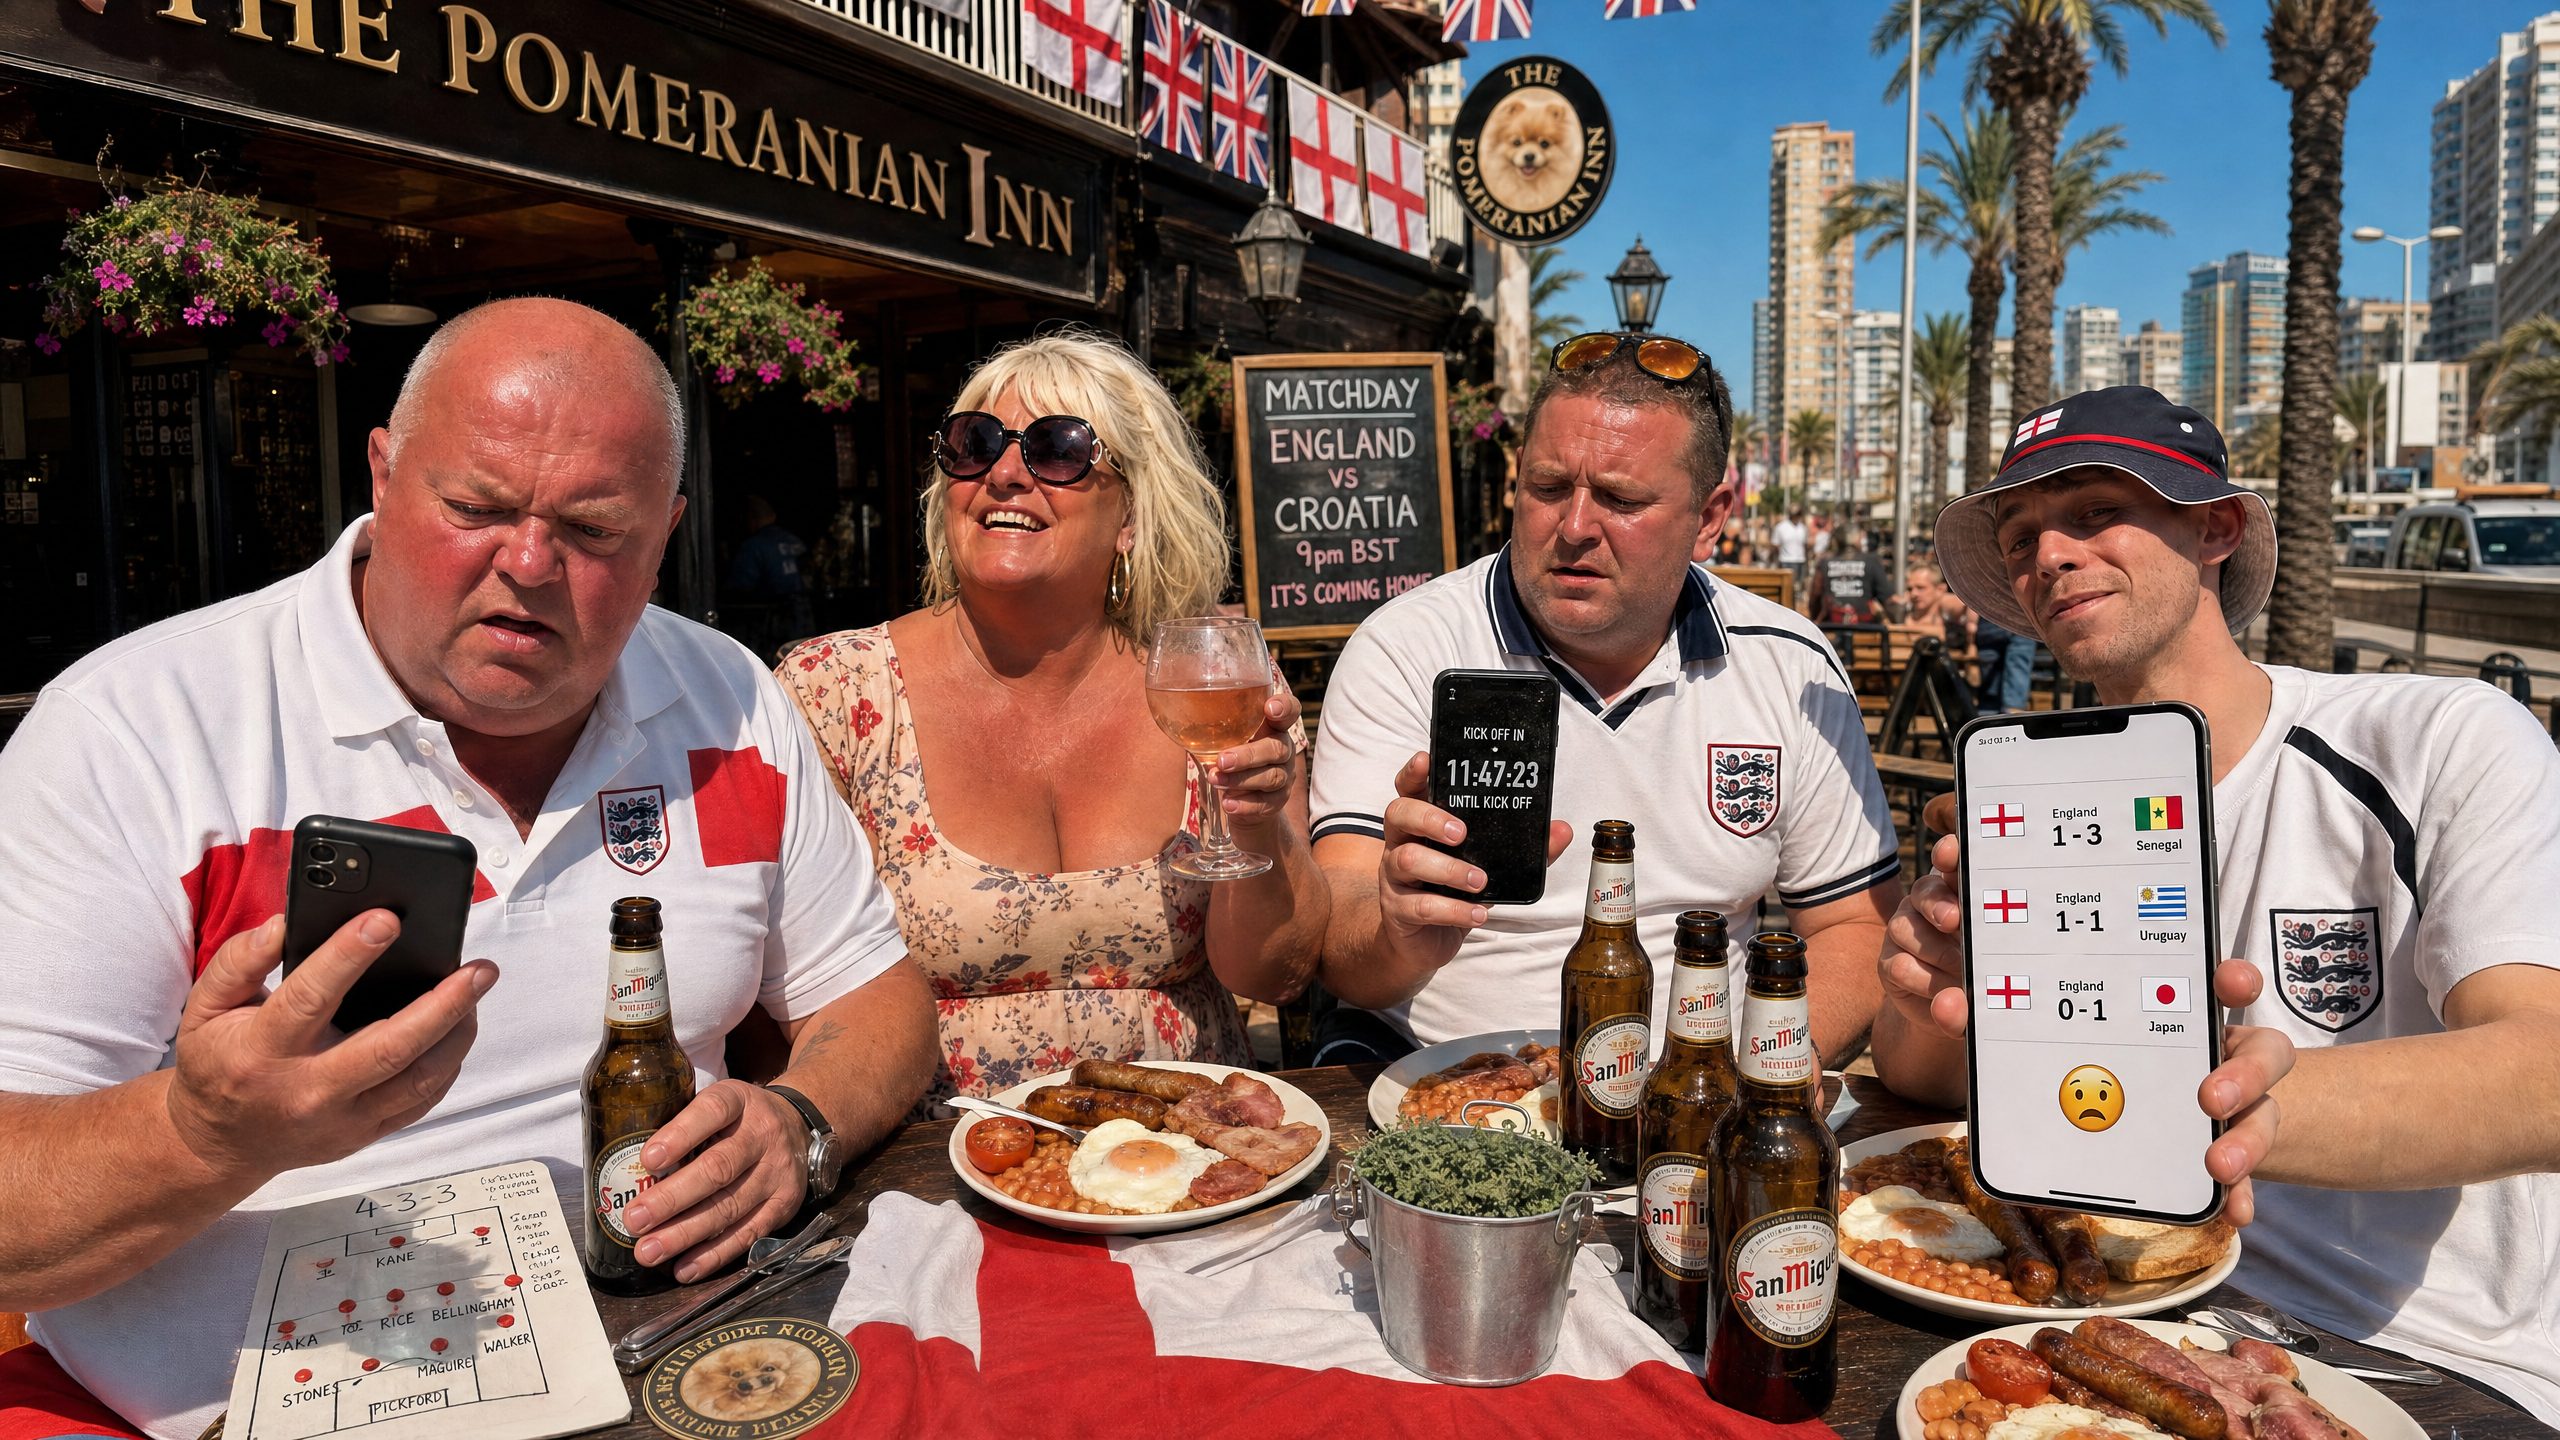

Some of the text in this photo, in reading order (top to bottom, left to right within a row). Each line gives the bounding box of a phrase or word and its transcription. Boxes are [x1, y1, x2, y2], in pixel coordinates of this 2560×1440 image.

[1504, 63, 1562, 87] THE
[439, 4, 949, 220] POMERANIAN
[961, 142, 1074, 256] INN
[1456, 126, 1606, 236] POMERANIAN INN
[1265, 377, 1420, 412] MATCHDAY
[1270, 427, 1416, 463] ENGLAND
[1274, 494, 1419, 533] CROATIA
[1296, 537, 1400, 574] 9pm BST
[1271, 581, 1308, 608] IT'S
[1313, 577, 1380, 604] COMING
[1463, 726, 1525, 742] KICK OFF IN
[1447, 759, 1539, 788] 11:47:23
[1449, 795, 1533, 810] UNTIL KICK OFF
[2052, 807, 2097, 820] England
[2136, 838, 2182, 853] Senegal
[2056, 892, 2101, 905] England
[2139, 930, 2187, 943] Uruguay
[2059, 980, 2104, 994] England
[2149, 1020, 2184, 1034] Japan
[355, 1184, 457, 1218] 4-3-3
[376, 1251, 416, 1268] KANE
[432, 1296, 515, 1321] BELLINGHAM
[380, 1312, 416, 1330] RICE
[271, 1334, 318, 1356] SAKA
[483, 1333, 531, 1354] WALKER
[418, 1357, 473, 1378] MAGUIRE
[282, 1382, 340, 1409] STONES
[373, 1391, 442, 1415] PICKFORD
